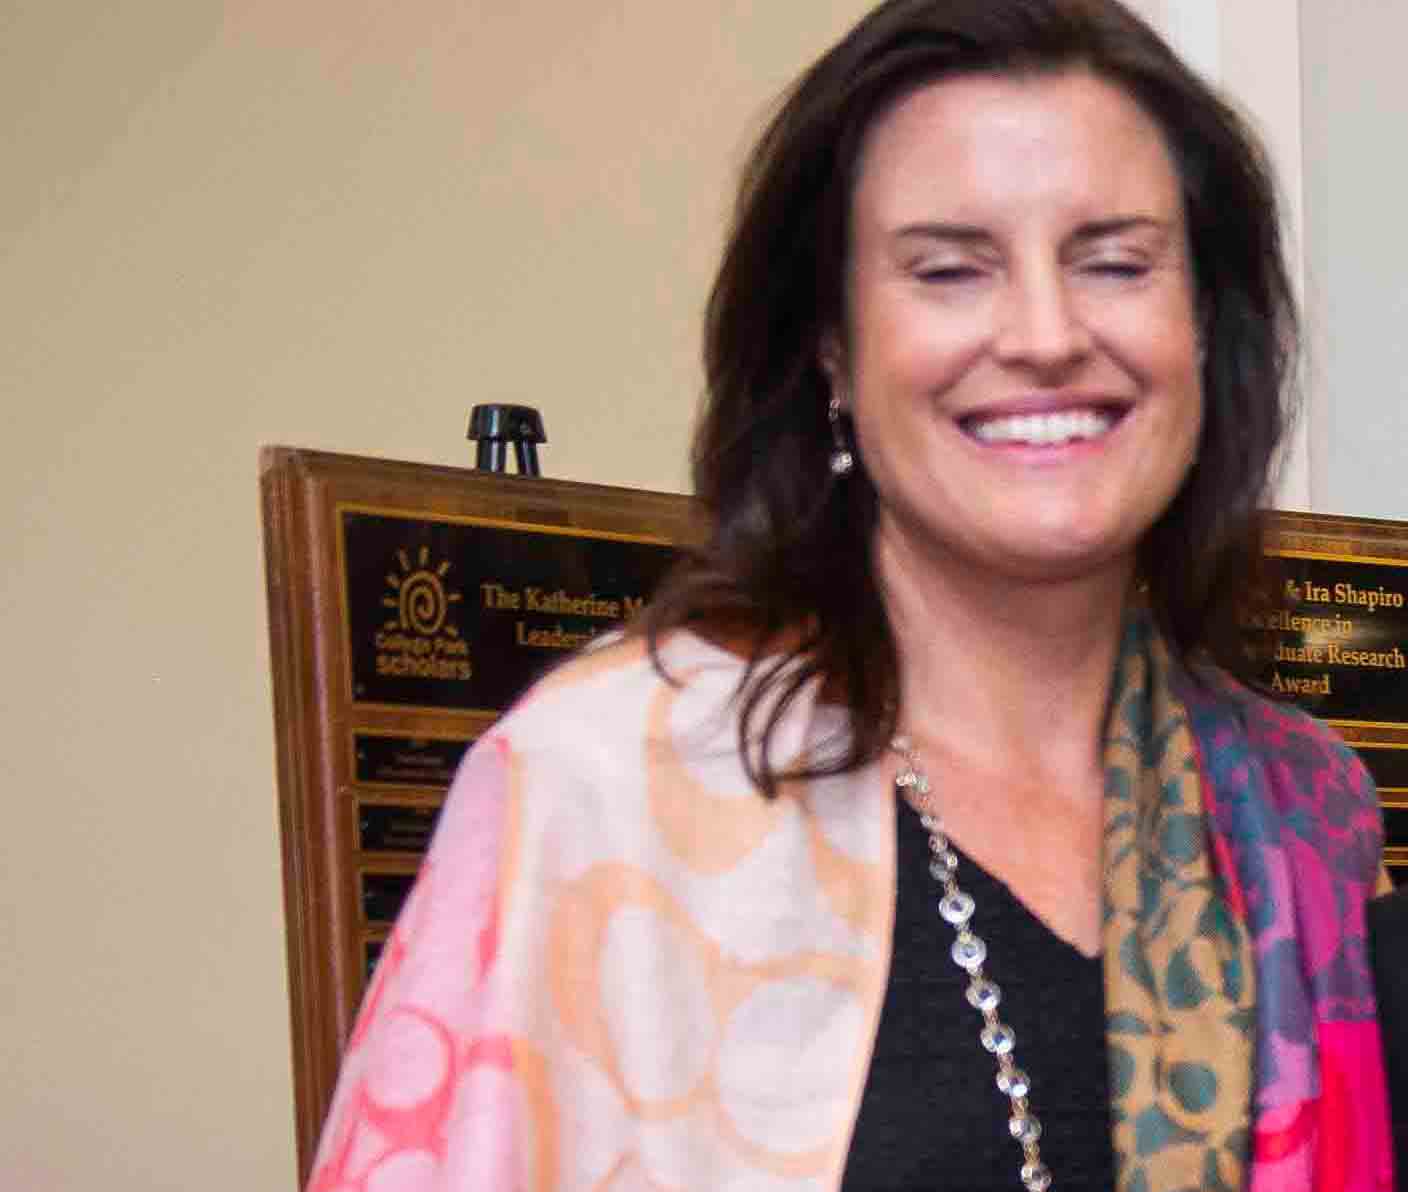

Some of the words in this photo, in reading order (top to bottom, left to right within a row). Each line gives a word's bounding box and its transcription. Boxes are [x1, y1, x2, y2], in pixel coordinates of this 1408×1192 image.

[480, 584, 520, 609] The
[525, 587, 619, 618] Katherine
[1303, 581, 1329, 602] Ira
[1335, 583, 1405, 612] Shapiro
[1334, 613, 1353, 636] in
[376, 654, 471, 680] scholars
[1328, 643, 1406, 669] Research
[1271, 671, 1334, 695] Award
